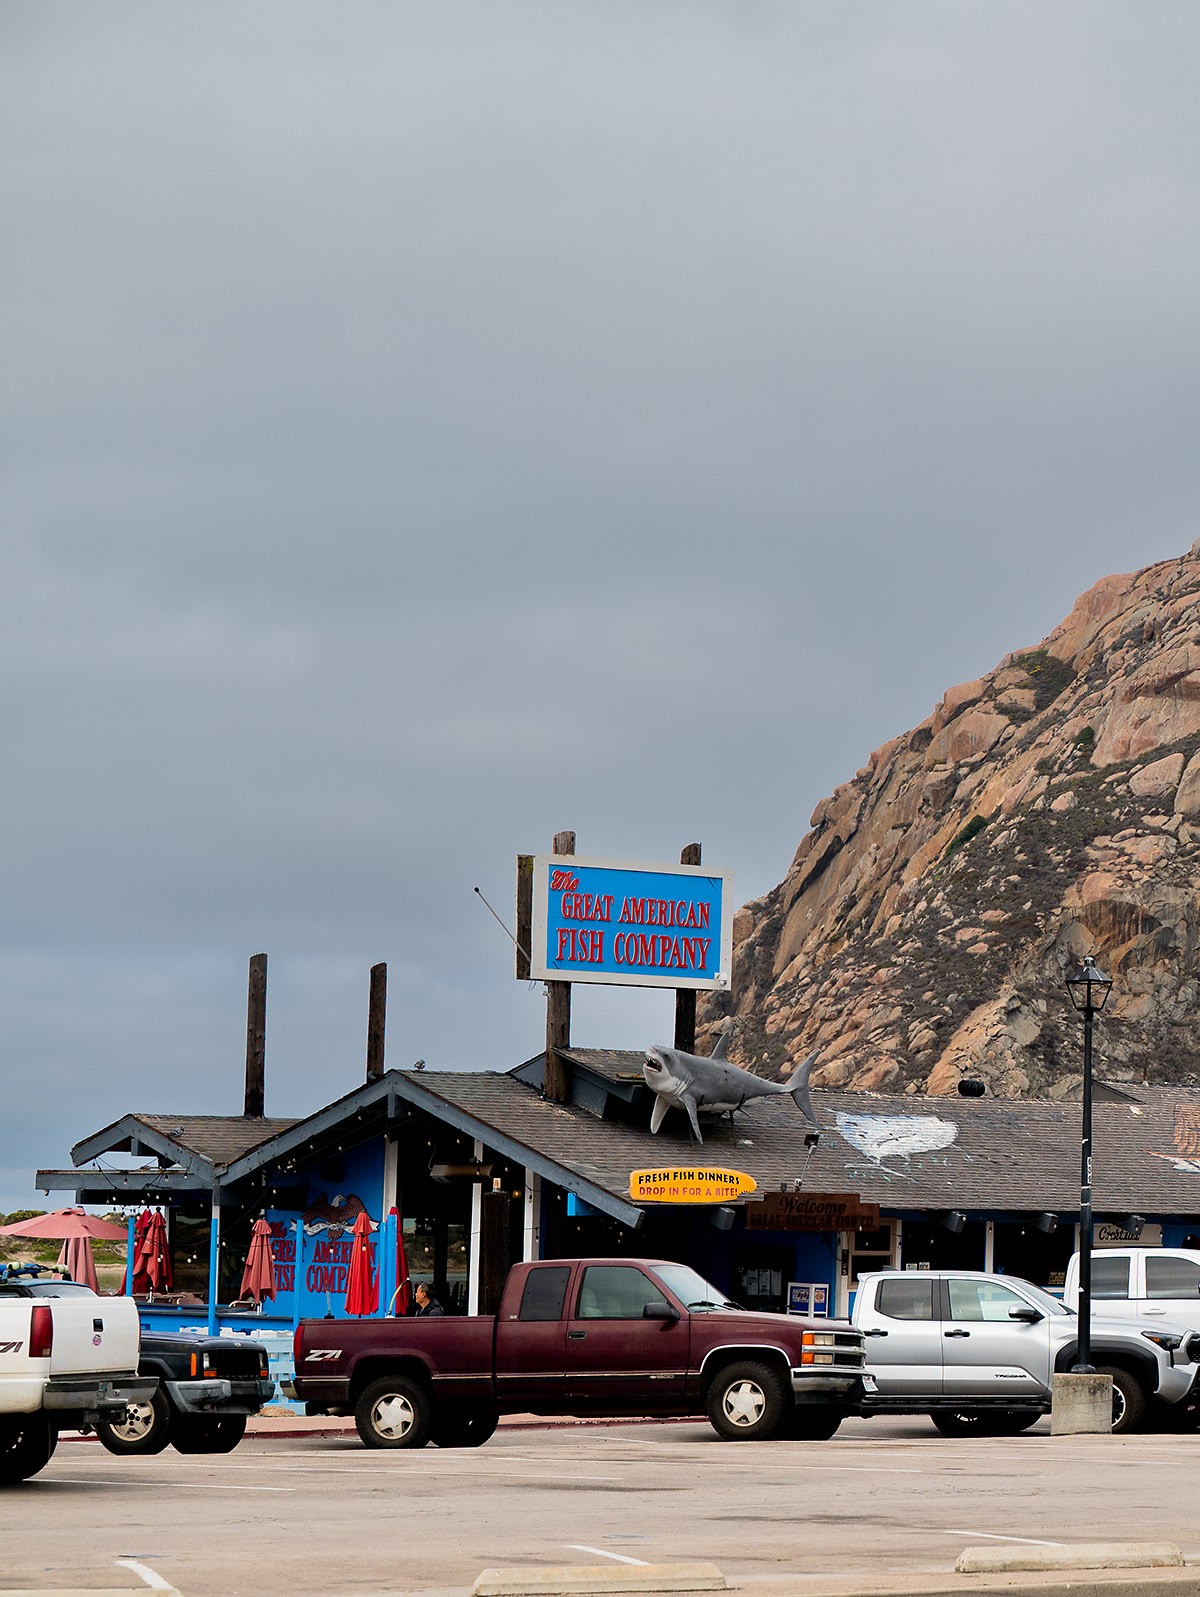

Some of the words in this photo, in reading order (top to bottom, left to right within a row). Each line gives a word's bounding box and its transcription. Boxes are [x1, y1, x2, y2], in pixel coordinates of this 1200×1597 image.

[550, 869, 580, 891] The
[561, 892, 614, 922] GREAT
[617, 896, 711, 930] AMERICAN
[555, 927, 605, 964] FISH
[613, 932, 712, 971] COMPANY
[638, 1172, 670, 1185] FRESH
[673, 1171, 695, 1181] FISH
[697, 1171, 740, 1185] DINNERS
[639, 1187, 666, 1196] DROP
[668, 1187, 679, 1196] IN
[682, 1187, 702, 1196] FOR
[705, 1187, 712, 1196] A
[715, 1188, 738, 1197] BITE!
[780, 1196, 847, 1215] Welcome
[836, 1215, 857, 1227] FISH
[312, 1241, 378, 1265] AMERIN
[0, 1341, 24, 1353] 71
[305, 1349, 342, 1361] Z71
